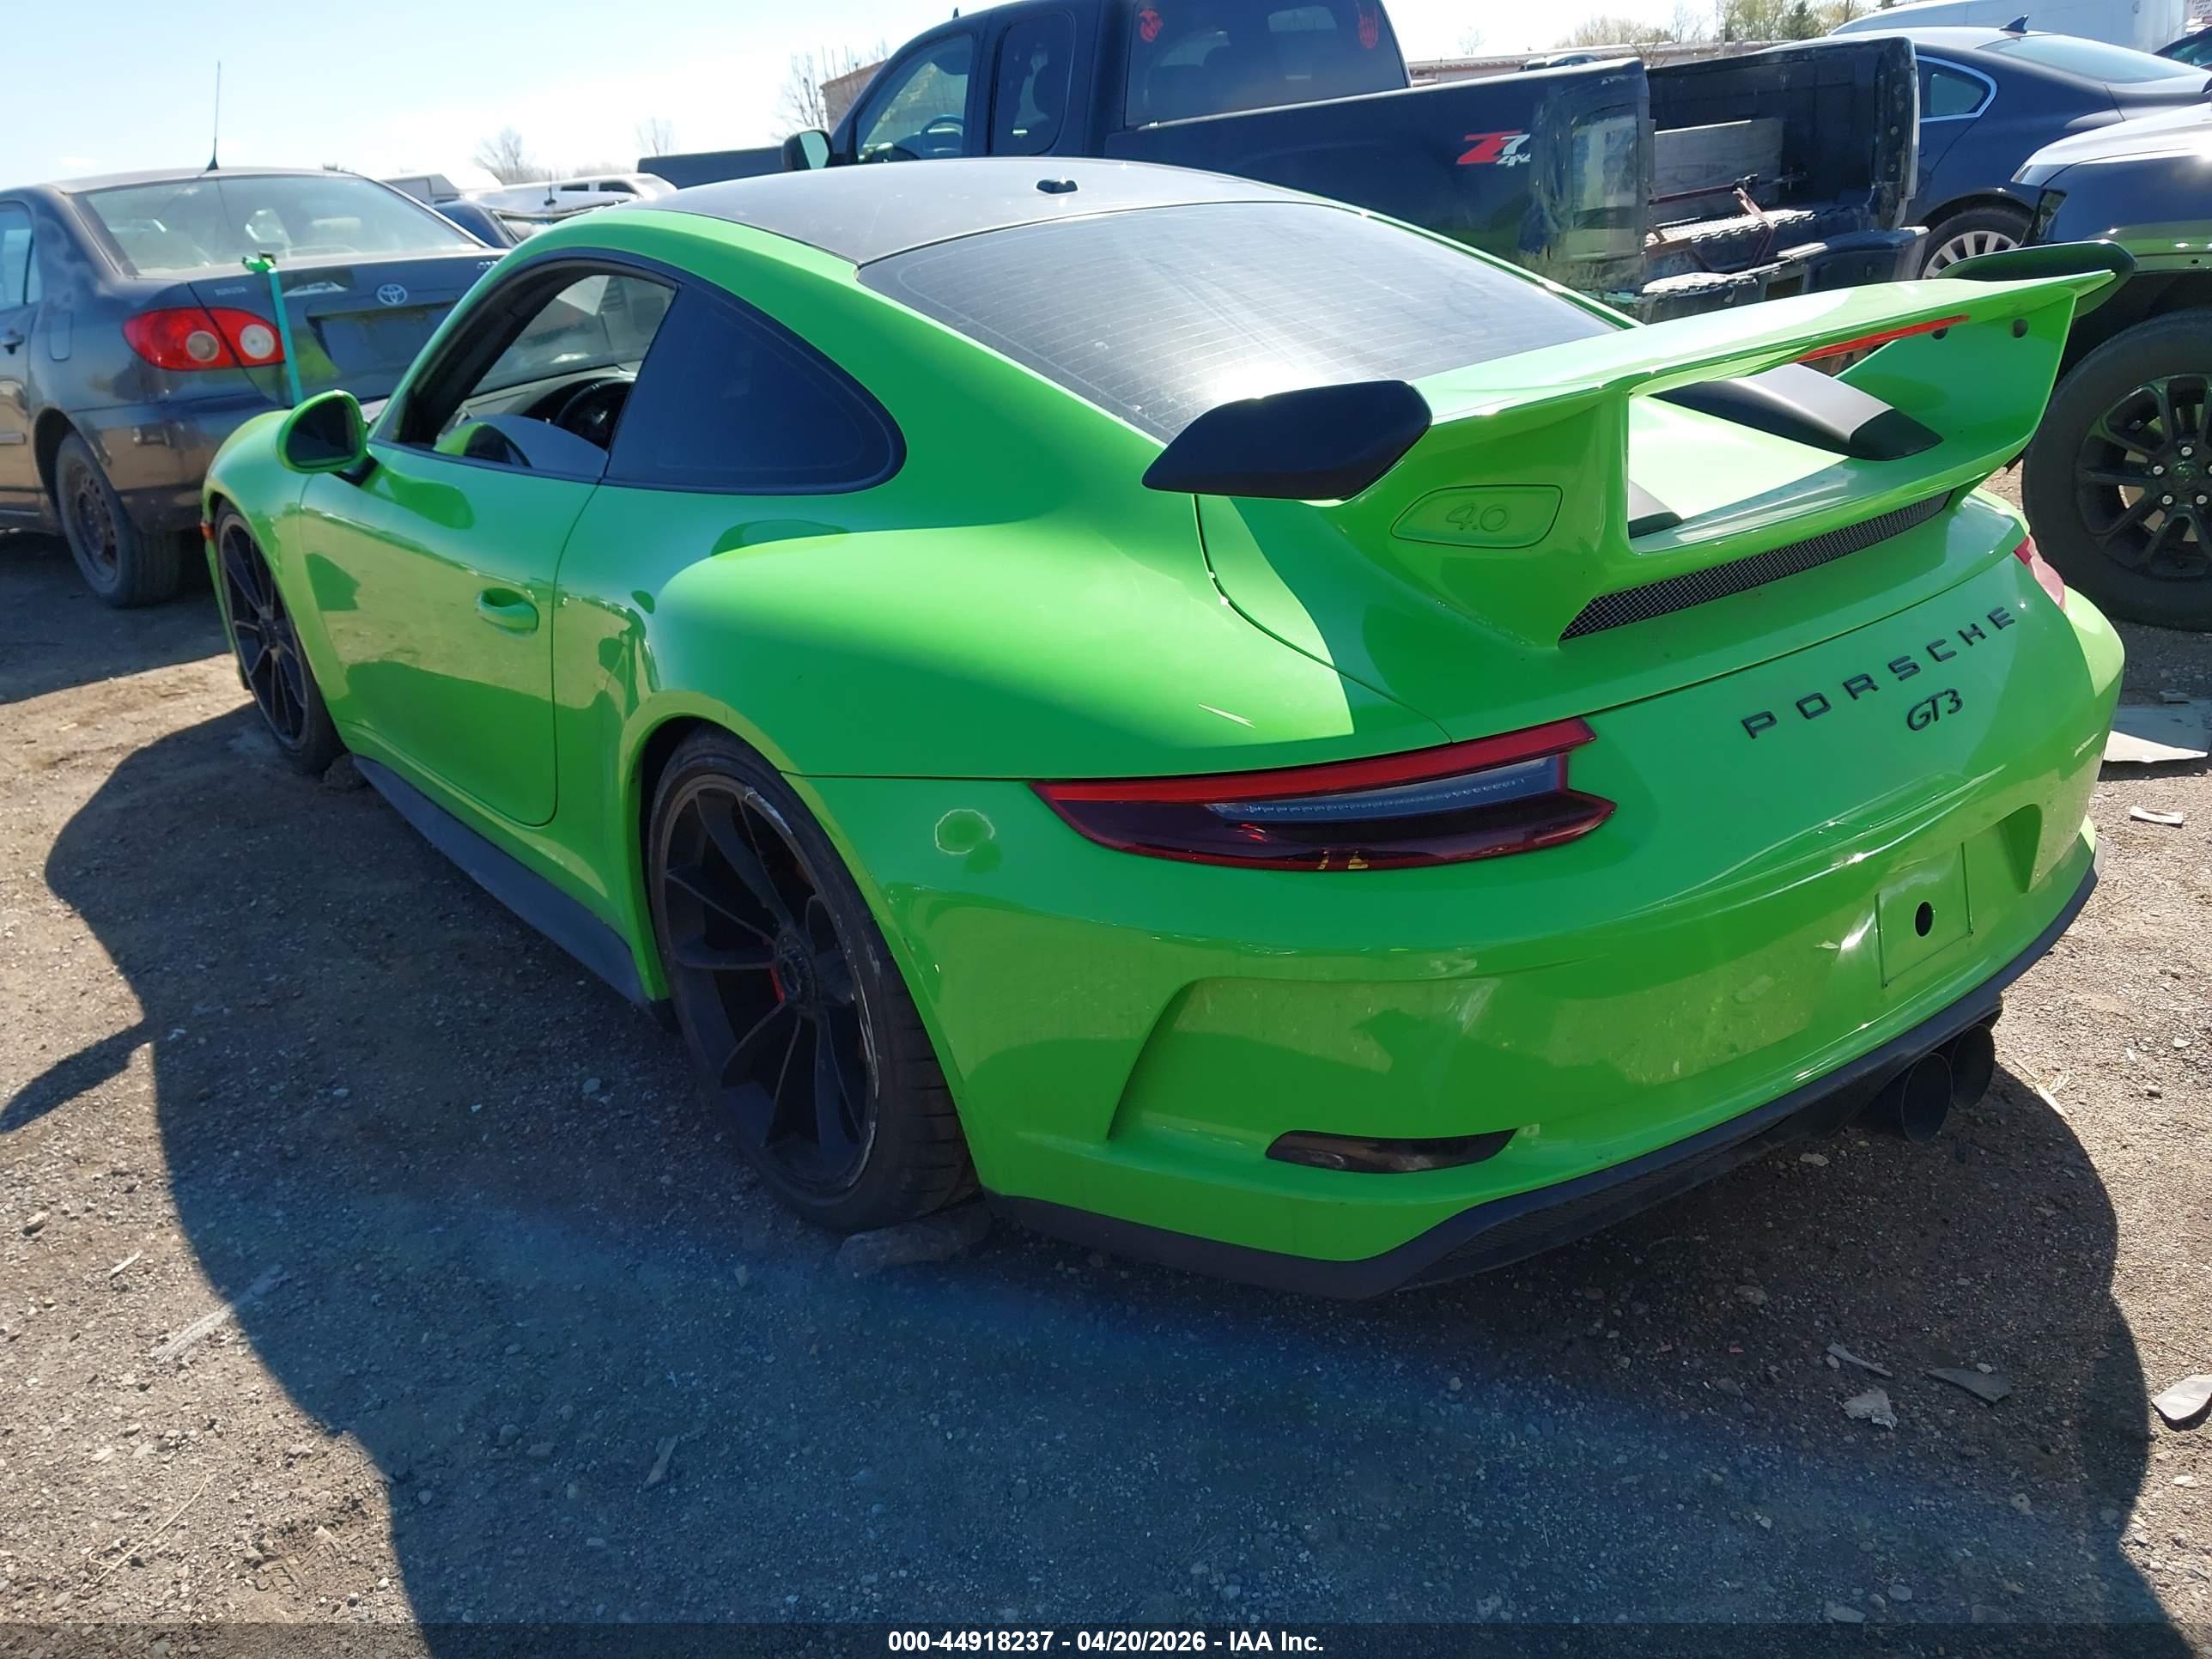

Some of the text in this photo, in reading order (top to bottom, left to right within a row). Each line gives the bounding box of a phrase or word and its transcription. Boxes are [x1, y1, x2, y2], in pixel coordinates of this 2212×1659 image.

[1445, 503, 1511, 532] 4.0
[1741, 606, 2015, 739] PORSCHE
[1907, 689, 1963, 731] GT3
